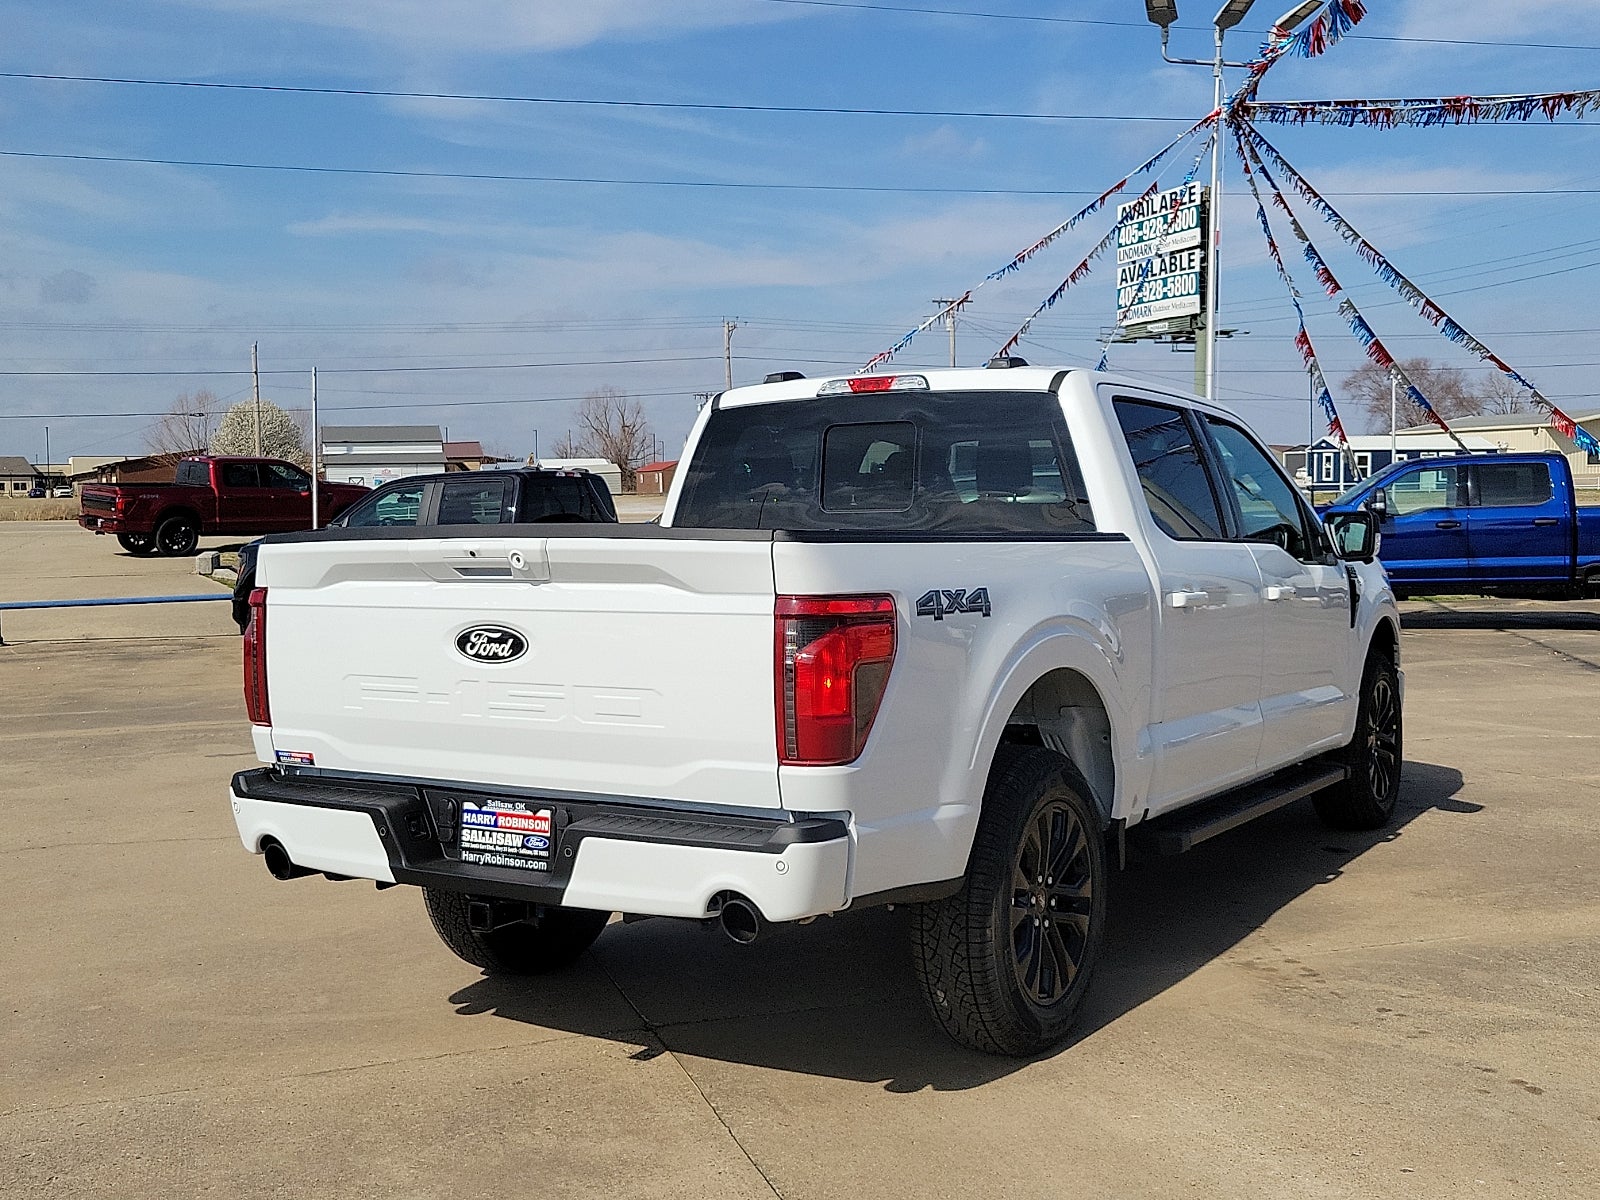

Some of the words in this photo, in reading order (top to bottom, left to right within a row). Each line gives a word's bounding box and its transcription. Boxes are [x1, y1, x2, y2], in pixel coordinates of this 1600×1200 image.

[1118, 273, 1196, 307] 405-928-5800
[463, 628, 516, 658] Ford
[515, 802, 526, 811] OK
[463, 812, 497, 826] HARRY
[497, 815, 549, 831] ROBINSON
[461, 829, 523, 847] SALLISAW
[526, 836, 546, 847] Ford
[462, 850, 547, 871] HarryRobinson.com
